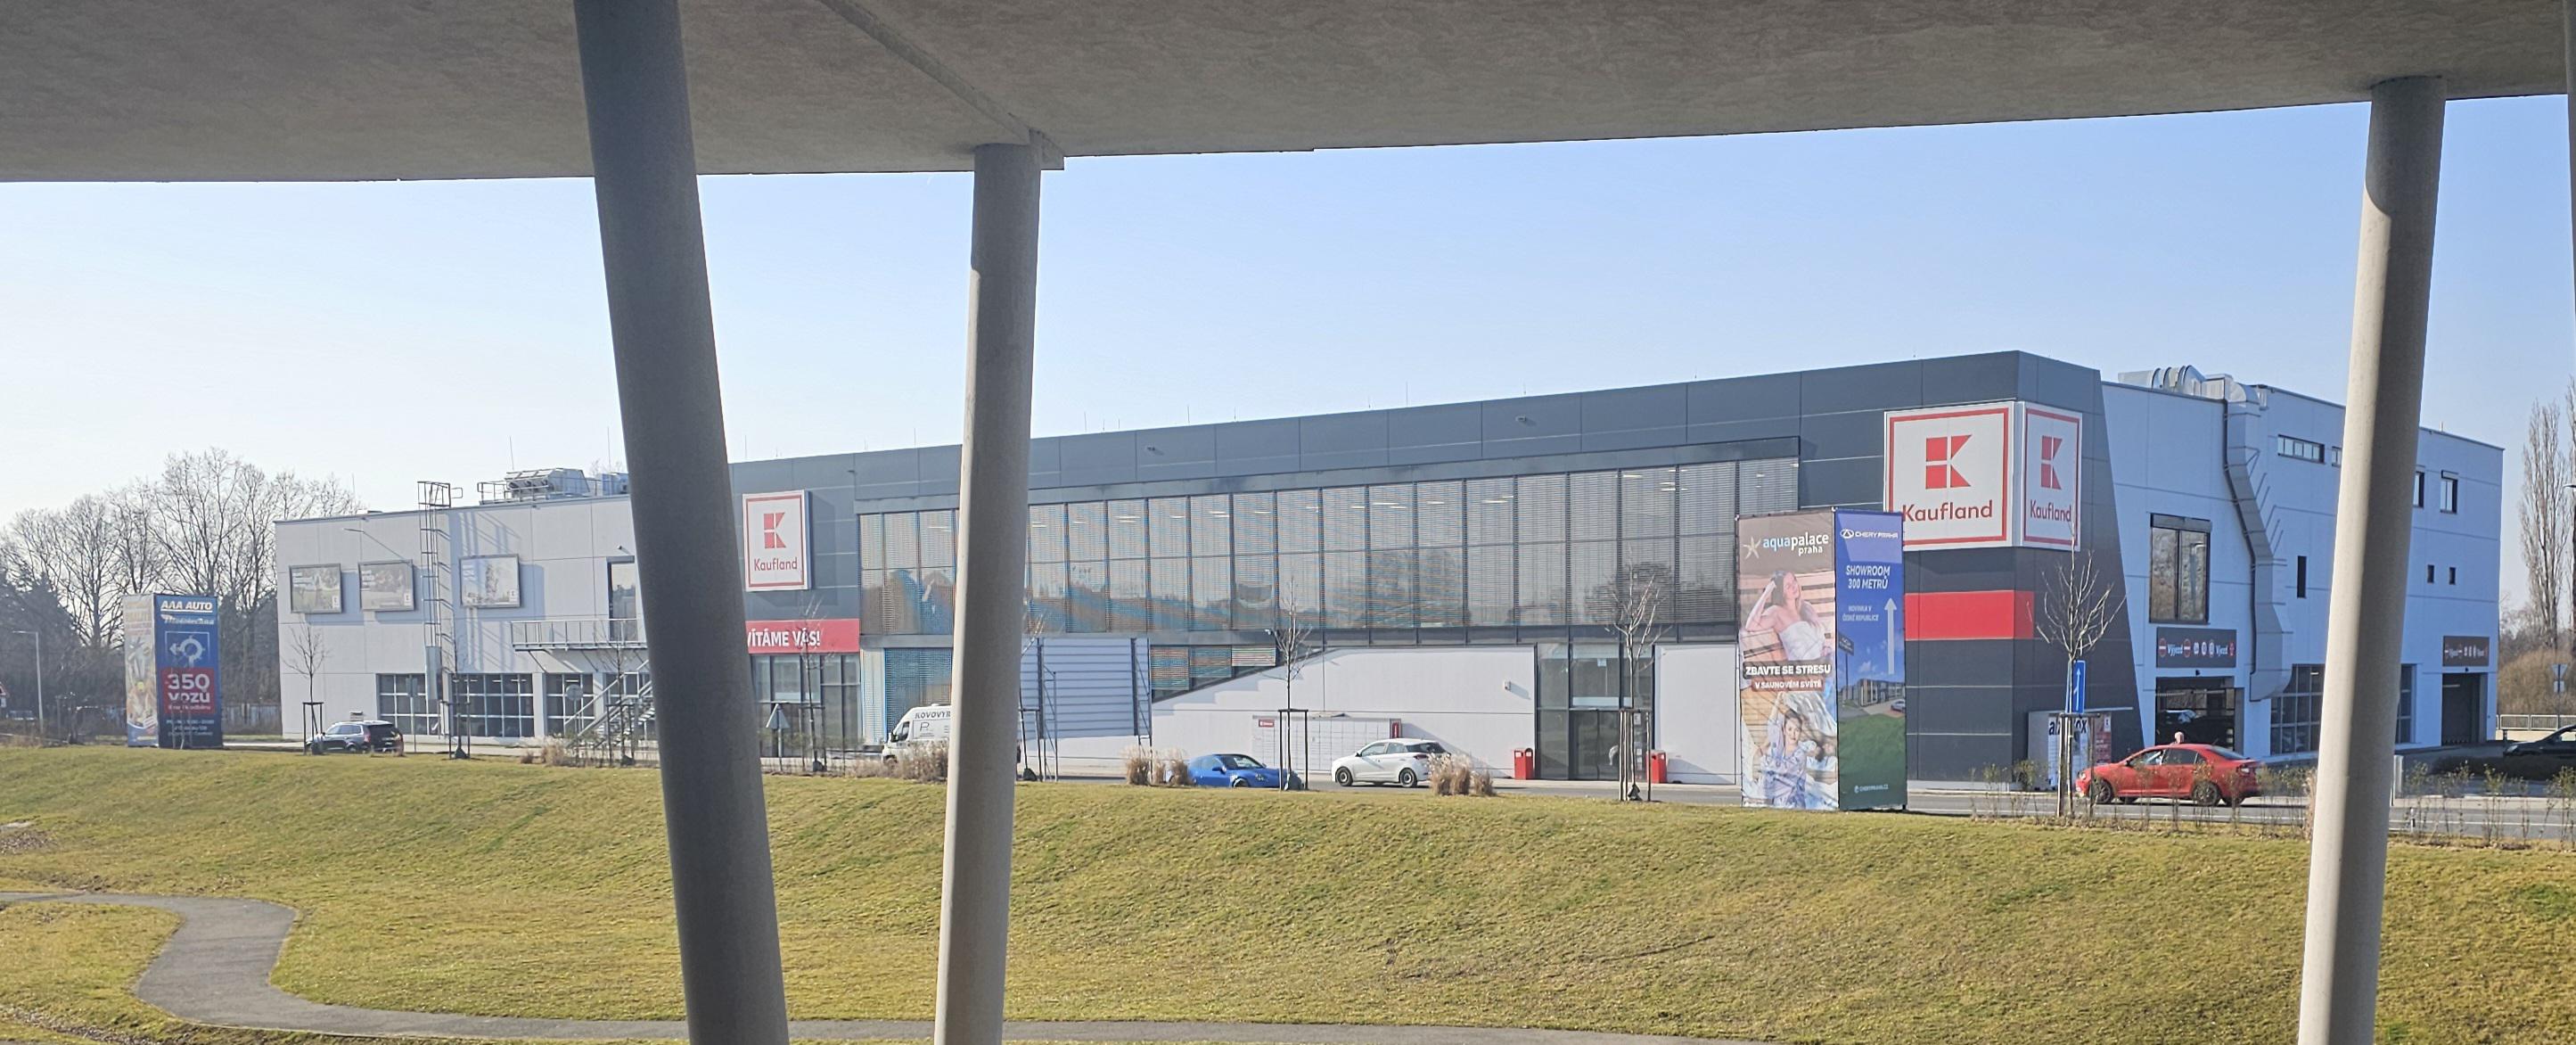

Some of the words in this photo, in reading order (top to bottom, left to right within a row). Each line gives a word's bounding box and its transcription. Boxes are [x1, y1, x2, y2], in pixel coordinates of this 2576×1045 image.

[1902, 499, 1993, 522] Kaufland
[2030, 499, 2072, 522] Kaufland
[1763, 531, 1829, 552] aquapalace
[1798, 546, 1823, 556] praha
[753, 557, 798, 572] Kaufland
[1846, 565, 1890, 576] SHOWROOM
[1848, 578, 1861, 589] 300
[160, 600, 183, 610] AAA
[185, 601, 213, 611] AUTO
[792, 627, 821, 647] VÁS!
[1745, 666, 1781, 676] ZBAVTE
[1782, 665, 1794, 675] SE
[1795, 664, 1832, 675] STRESU
[168, 673, 210, 690] 350
[1754, 681, 1760, 689] V
[1760, 679, 1799, 689] SAUNOVÉM
[2048, 719, 2088, 736] alox
